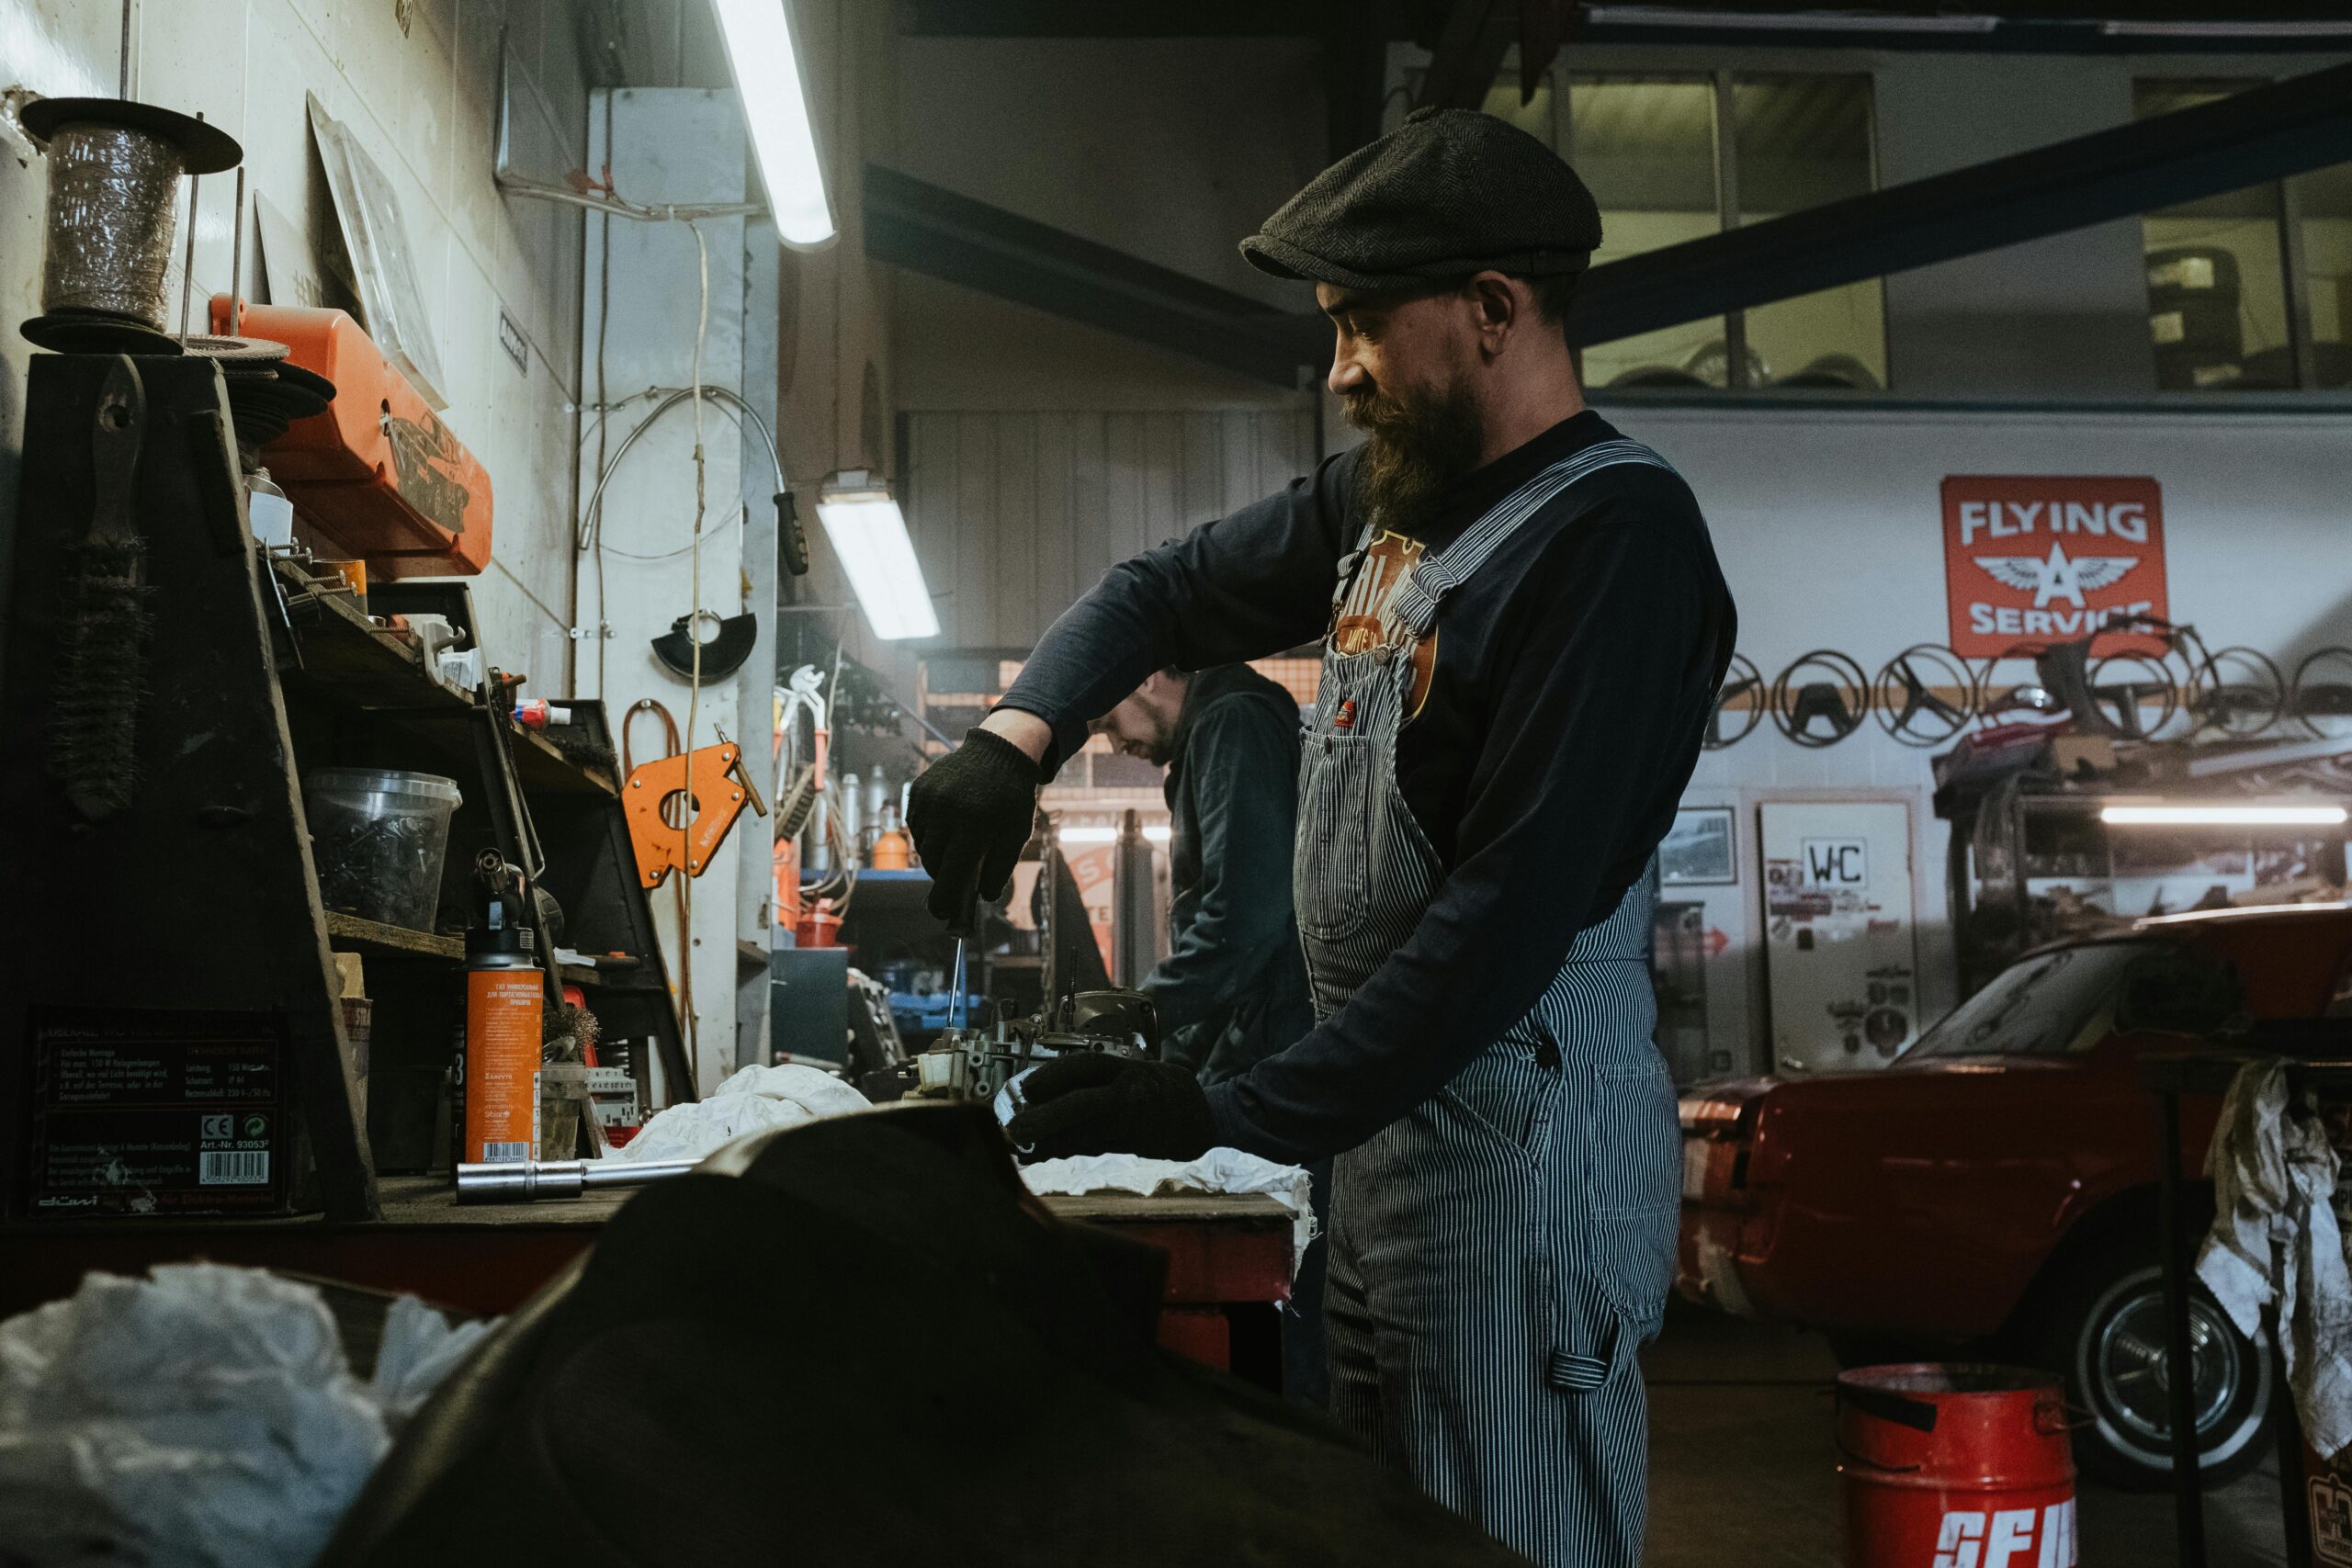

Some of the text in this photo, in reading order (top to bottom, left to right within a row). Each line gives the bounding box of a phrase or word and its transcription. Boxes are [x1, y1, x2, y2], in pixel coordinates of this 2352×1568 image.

[1959, 502, 2148, 546] FLYING
[2033, 540, 2086, 607] A
[1809, 845, 1861, 882] WC
[227, 1089, 241, 1098] 230
[200, 1140, 234, 1149] Art.-Nr.
